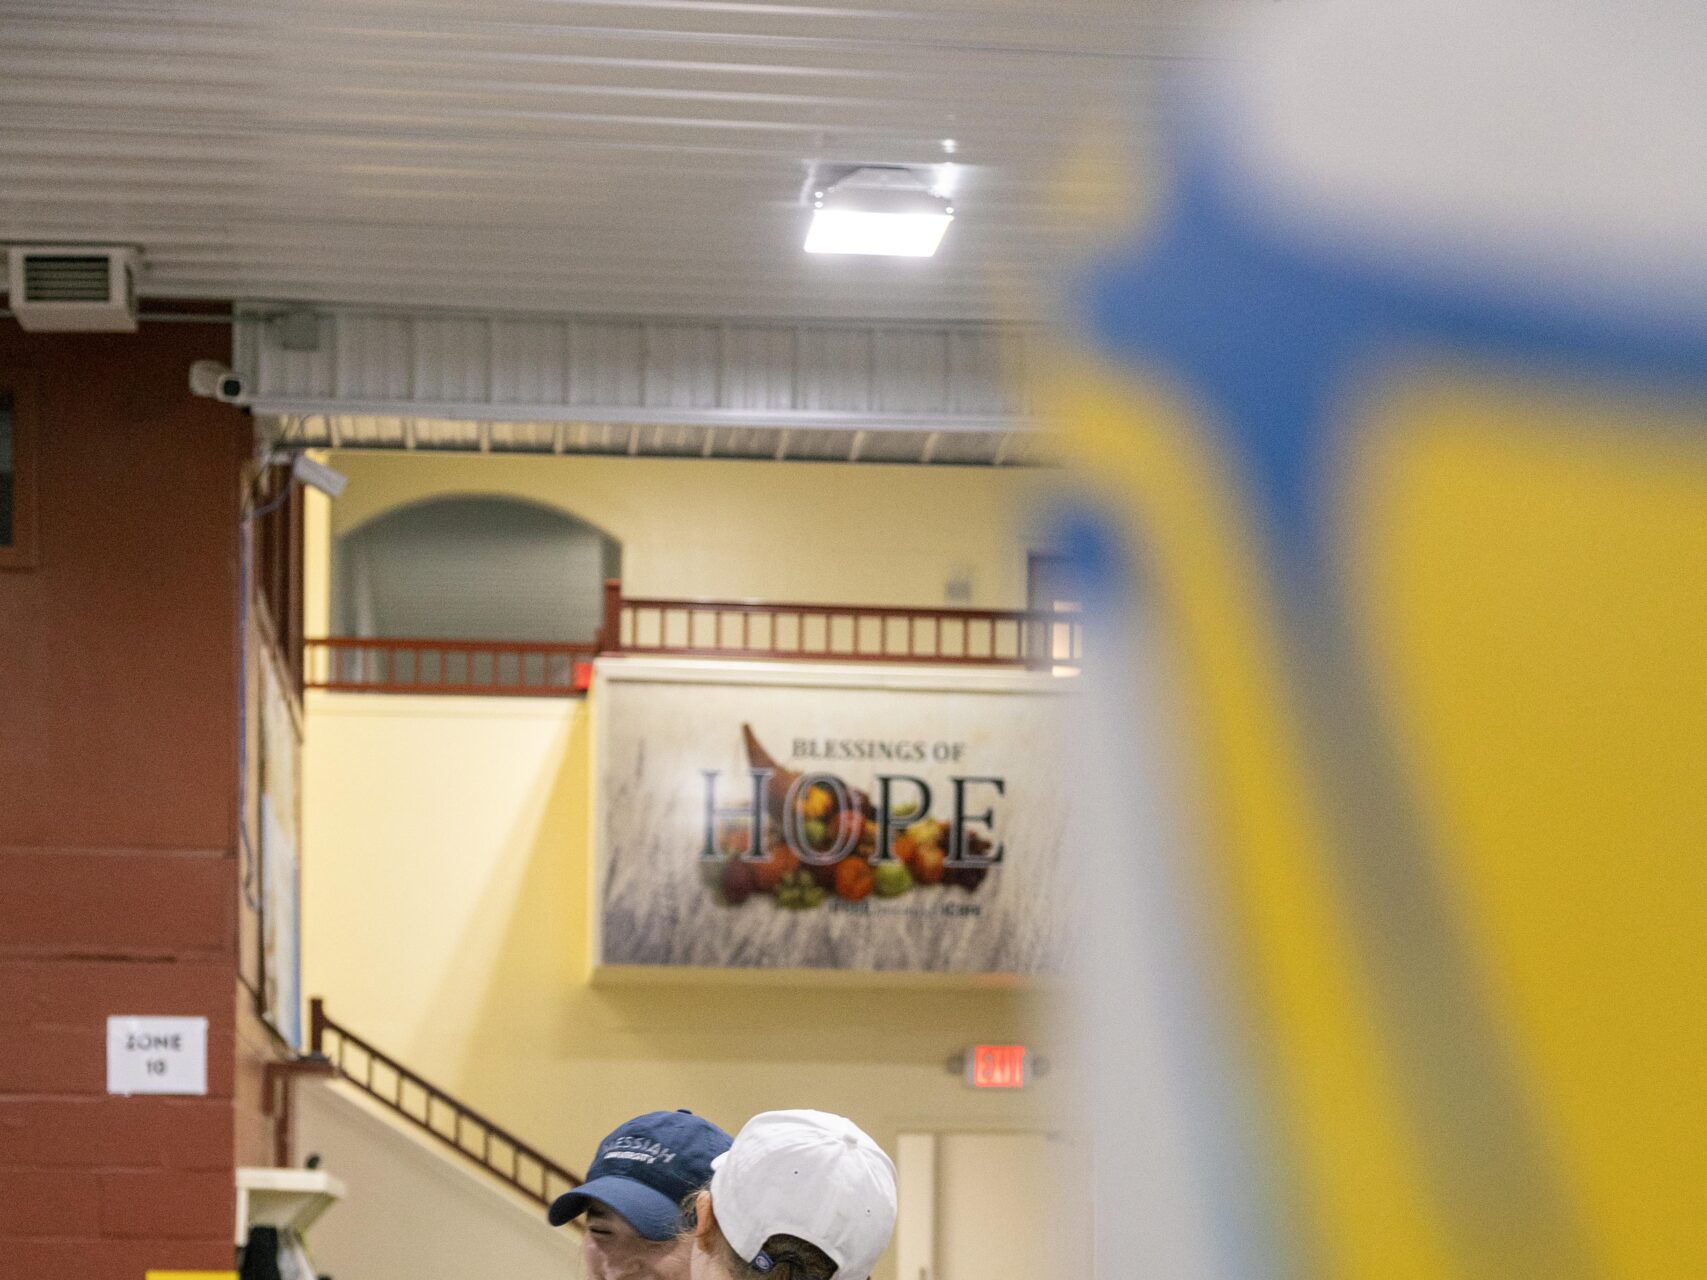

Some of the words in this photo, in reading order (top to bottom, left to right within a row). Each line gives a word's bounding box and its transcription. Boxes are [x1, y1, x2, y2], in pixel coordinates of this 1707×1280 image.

[791, 738, 925, 761] BLESSINGS
[932, 741, 967, 761] OF
[698, 768, 1006, 868] HOPE
[126, 1033, 182, 1051] ZONE
